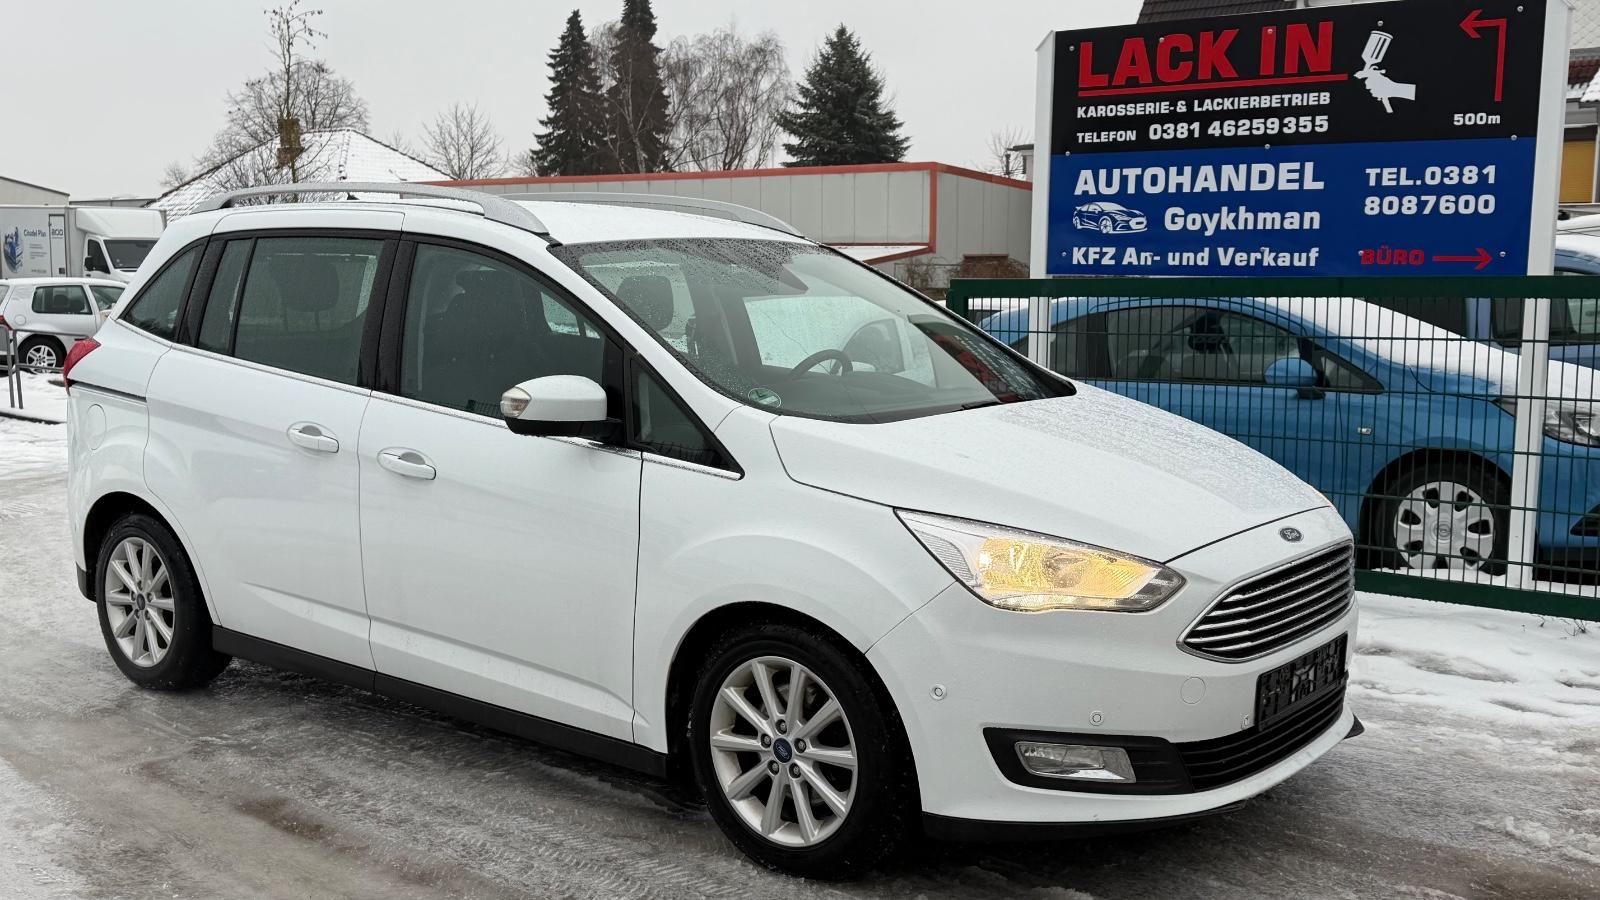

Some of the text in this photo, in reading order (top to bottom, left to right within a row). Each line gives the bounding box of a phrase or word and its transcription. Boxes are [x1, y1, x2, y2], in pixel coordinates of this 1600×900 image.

[1078, 21, 1334, 87] LACK IN
[1193, 92, 1331, 112] LACKIERBETRIEB
[1453, 112, 1501, 126] 500m
[1077, 129, 1137, 143] TELEFON
[1149, 122, 1201, 140] 0381
[1074, 161, 1325, 196] AUTOHANDEL
[1364, 194, 1496, 215] 8087600
[1164, 205, 1321, 236] Goykhman
[1072, 247, 1320, 267] KFZ An- und Verkauf
[1360, 245, 1425, 265] BÜRO
